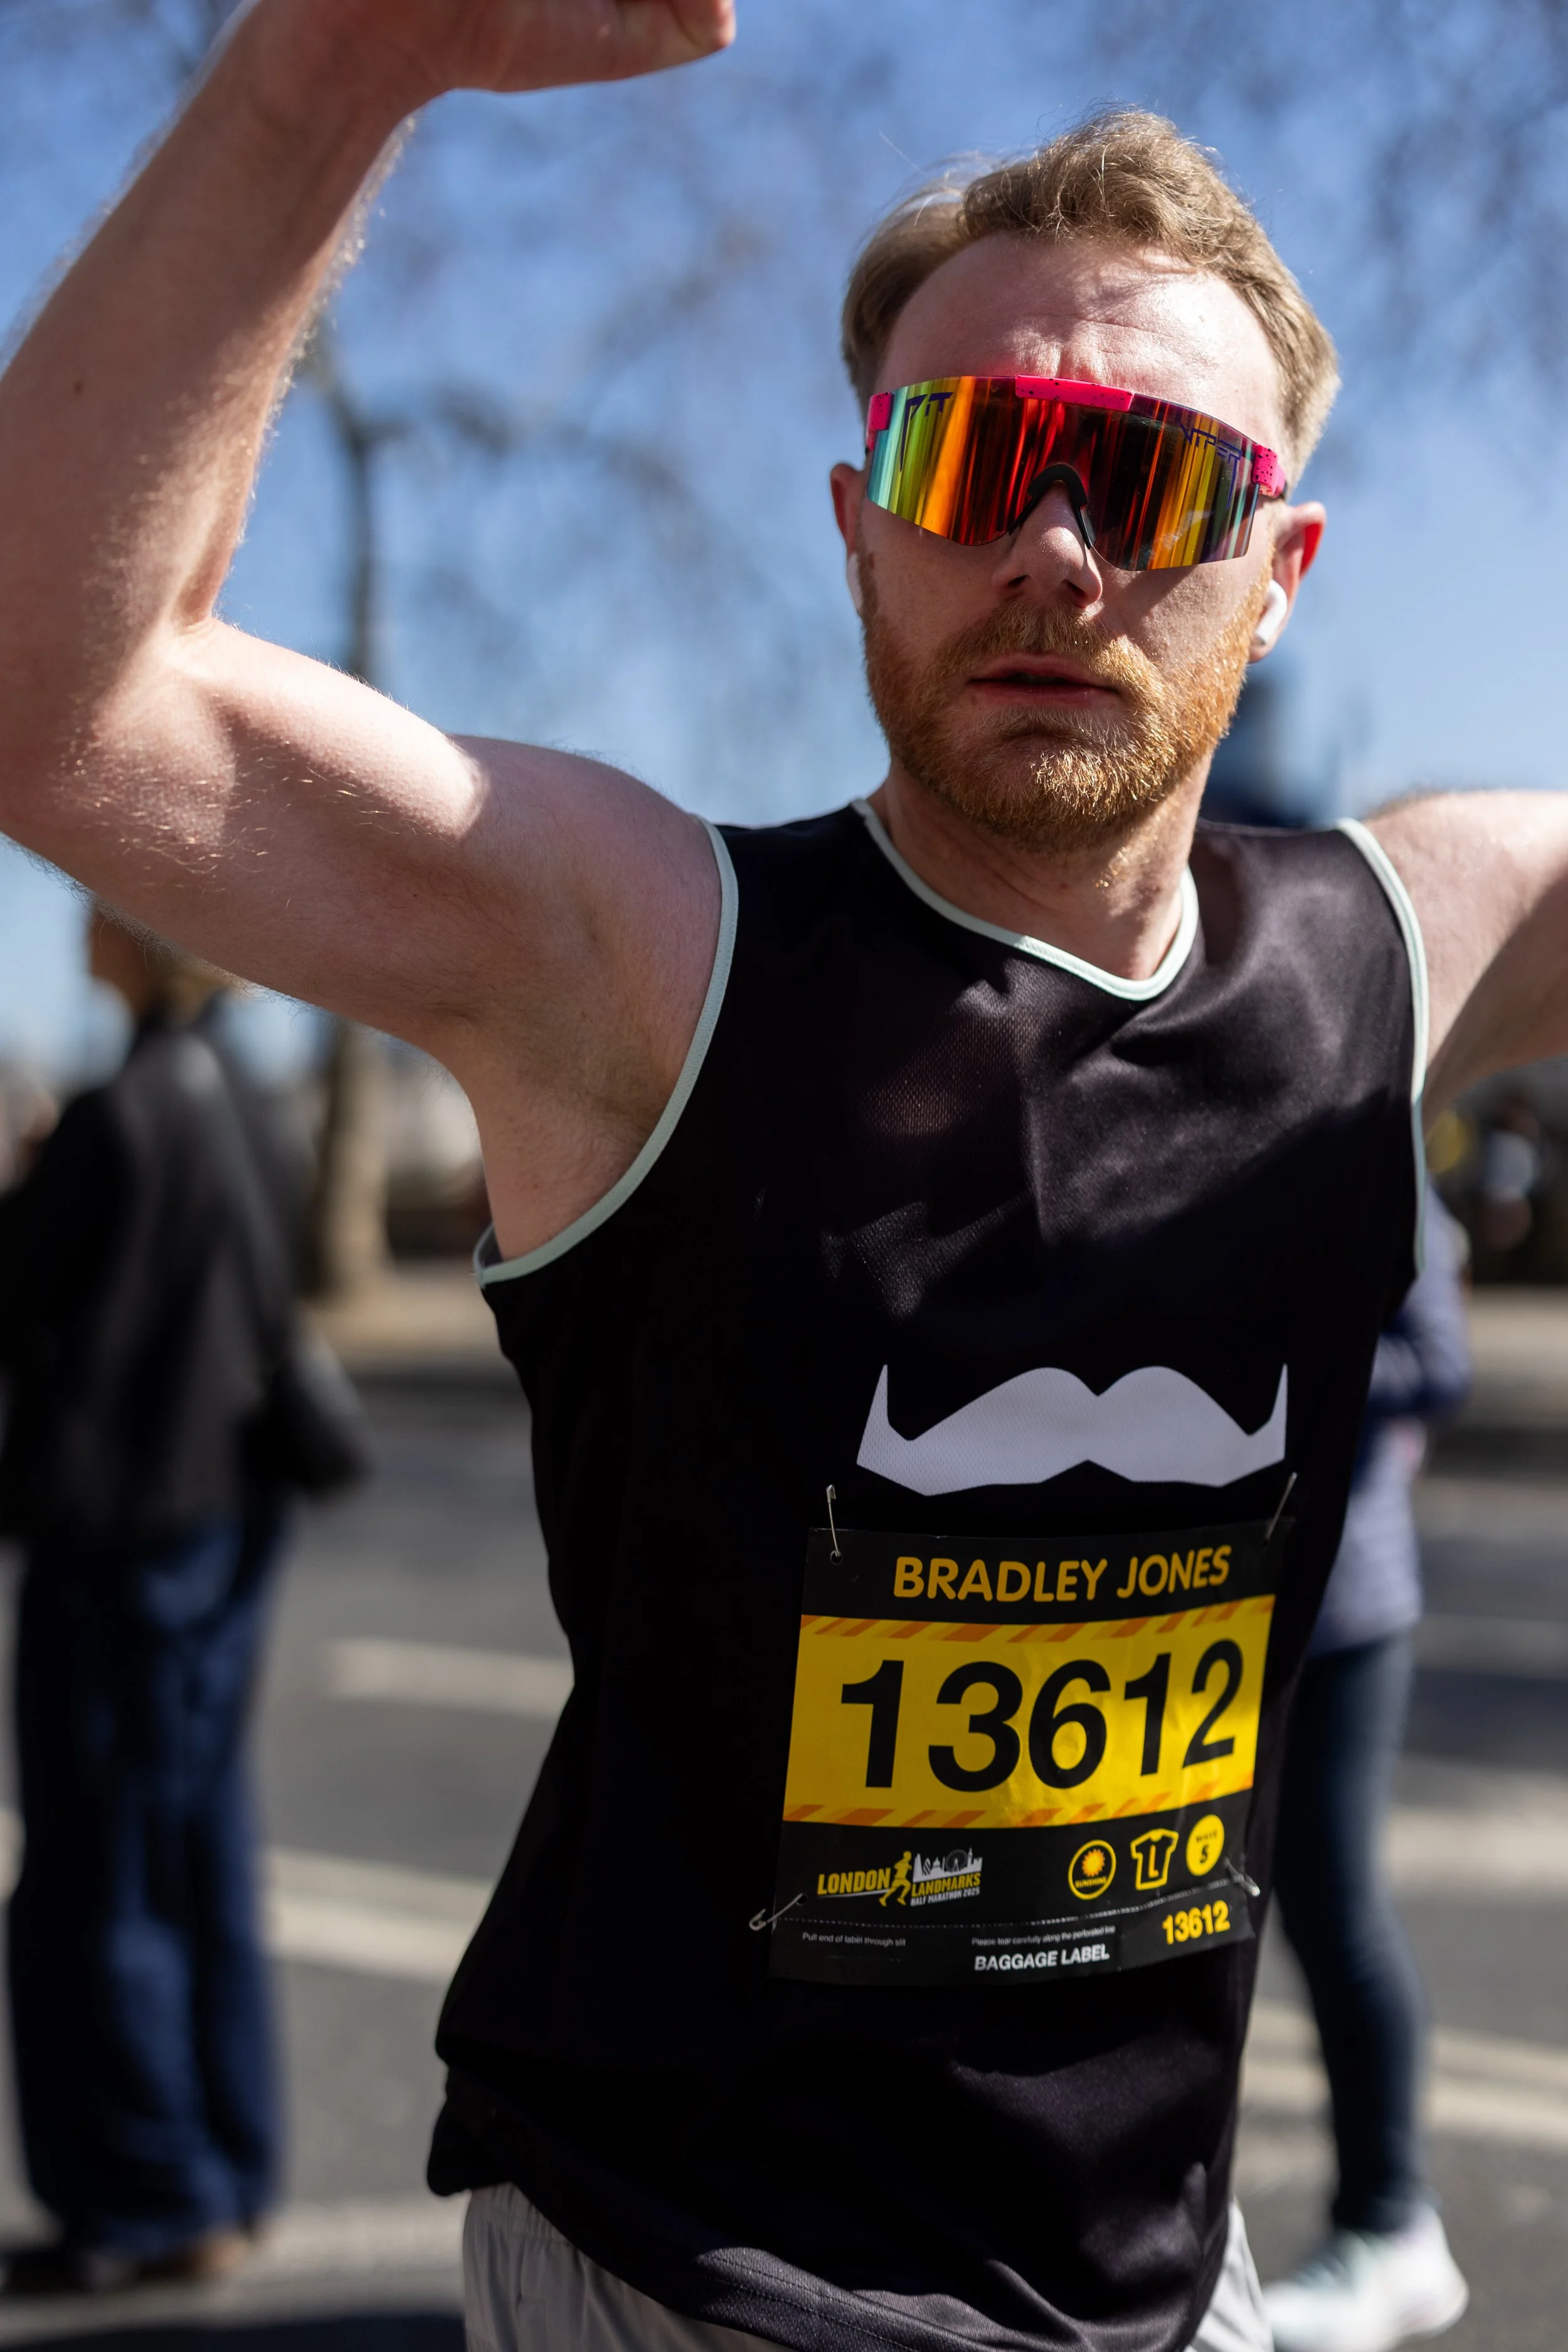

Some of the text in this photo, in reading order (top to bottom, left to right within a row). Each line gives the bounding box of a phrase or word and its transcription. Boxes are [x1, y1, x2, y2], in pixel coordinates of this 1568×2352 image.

[1179, 423, 1242, 511] VIPER
[894, 1545, 1232, 1602] BRADLEY JONES
[841, 1638, 1244, 1792] 13612
[1148, 1845, 1159, 1878] L
[1200, 1845, 1209, 1864] 5
[817, 1868, 891, 1895] LONDON
[911, 1873, 981, 1897] LANDMARKS
[1075, 1876, 1107, 1888] SUNSHINE
[911, 1887, 980, 1907] HALF MARATHON 2025
[1162, 1900, 1230, 1944] 13612
[802, 1932, 817, 1941] Pull
[835, 1935, 843, 1943] of
[845, 1935, 862, 1944] label
[864, 1937, 893, 1947] through
[972, 1937, 995, 1946] Please
[1012, 1935, 1041, 1945] carefully
[1042, 1933, 1061, 1944] along
[1073, 1928, 1104, 1939] perforated
[1104, 1926, 1115, 1934] line
[974, 1943, 1110, 1971] BAGGAGE LABEL
